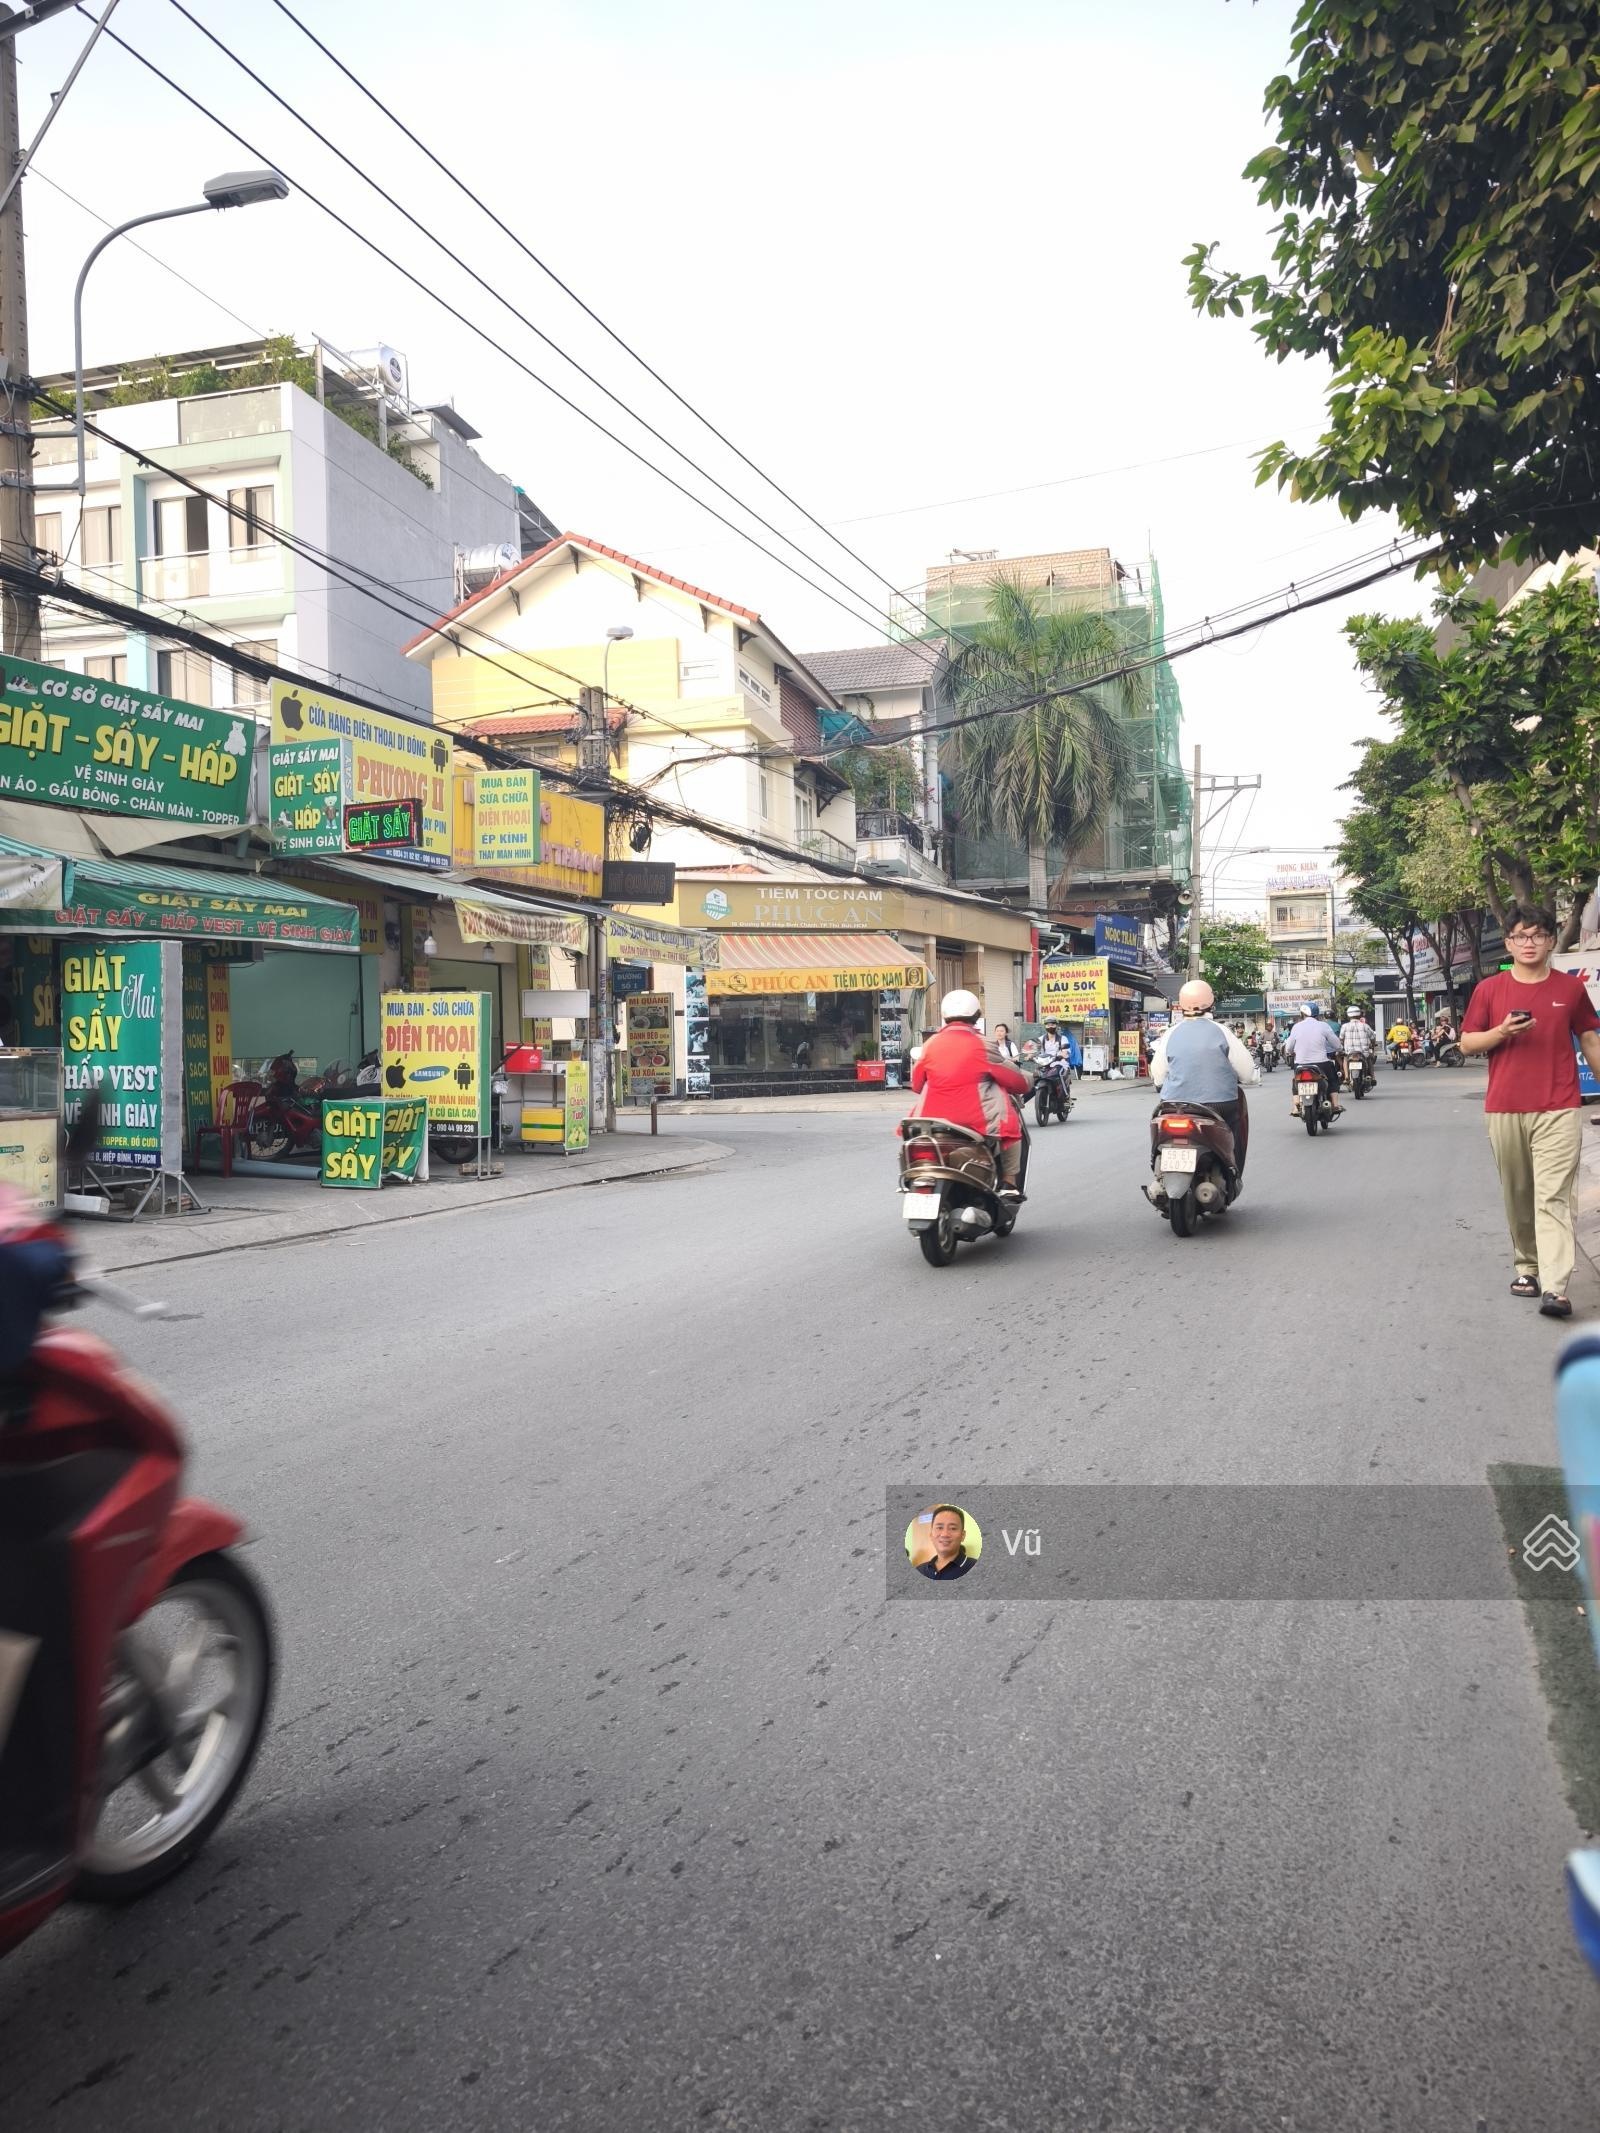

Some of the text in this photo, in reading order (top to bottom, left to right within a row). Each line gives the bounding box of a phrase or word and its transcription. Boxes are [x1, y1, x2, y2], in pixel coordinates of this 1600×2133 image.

[41, 680, 204, 732] CƠ SỞ GIẶT SẤY MAI
[308, 701, 326, 729] CỬA
[329, 709, 351, 735] HÀNG
[353, 718, 372, 744] ĐIỆN
[374, 726, 396, 752] THOẠI
[397, 735, 405, 751] DI
[93, 718, 160, 771] SẤY
[180, 739, 238, 787] HẤP
[272, 744, 339, 770] GIẶT SẤY MAI
[74, 764, 165, 793] VỆ SINH GIÀY
[274, 765, 341, 801] GIẶT SẤY
[481, 776, 527, 789] MUA BÁN
[16, 775, 37, 793] ÁO
[49, 780, 79, 800] GẤU
[82, 787, 120, 806] BÔNG
[130, 796, 164, 813] CHĂN
[167, 801, 194, 818] MÀN
[202, 809, 240, 826] TOPPER
[479, 791, 500, 805] SỬA
[502, 790, 529, 804] CHỮA
[294, 801, 321, 831] HẤP
[349, 811, 380, 845] GIẶT
[434, 818, 447, 834] PIN
[478, 806, 500, 830] ĐIỆN
[501, 809, 531, 829] THOẠI
[289, 836, 313, 849] SINH
[315, 832, 342, 848] GIÀY
[481, 831, 528, 844] ÉP KÍNH
[479, 849, 495, 860] THAY
[496, 848, 513, 860] MÀN
[514, 847, 531, 859] HÌNH
[138, 891, 308, 918] GIẶT SẤY MAI
[757, 886, 883, 903] TIỆM TÓC NAM
[55, 904, 102, 928] GIẶT
[105, 905, 147, 927] SẤY
[161, 909, 198, 931] HẤP
[202, 917, 244, 933] VEST
[257, 919, 277, 940] VỆ
[280, 924, 316, 940] SINH
[319, 925, 355, 944] GIÀY
[843, 905, 883, 923] AN
[64, 948, 126, 1000] GIẶT
[121, 974, 156, 1019] Mai
[752, 969, 903, 992] PHÚC AN TIỆM TÓC NAM
[1073, 981, 1096, 991] 50K
[32, 970, 55, 1028] SẤ
[386, 997, 475, 1017] MUA BÁN SỬA CHỮA
[1041, 1005, 1061, 1014] MUA
[1064, 1004, 1070, 1013] 2
[69, 1003, 122, 1051] SẤY
[386, 1018, 476, 1060] ĐIỆN THOẠI
[64, 1054, 157, 1091] HẤP VEST
[414, 1070, 445, 1078] SAMSUNG
[125, 1099, 157, 1128] GIÀY
[440, 1093, 476, 1105] MÀN HÌNH
[447, 1106, 460, 1118] GIÁ
[461, 1109, 477, 1118] CAO
[324, 1106, 381, 1144] GIẶT
[384, 1102, 425, 1138] GIẶT
[326, 1144, 377, 1180] SẤY
[383, 1139, 415, 1168] ẤY
